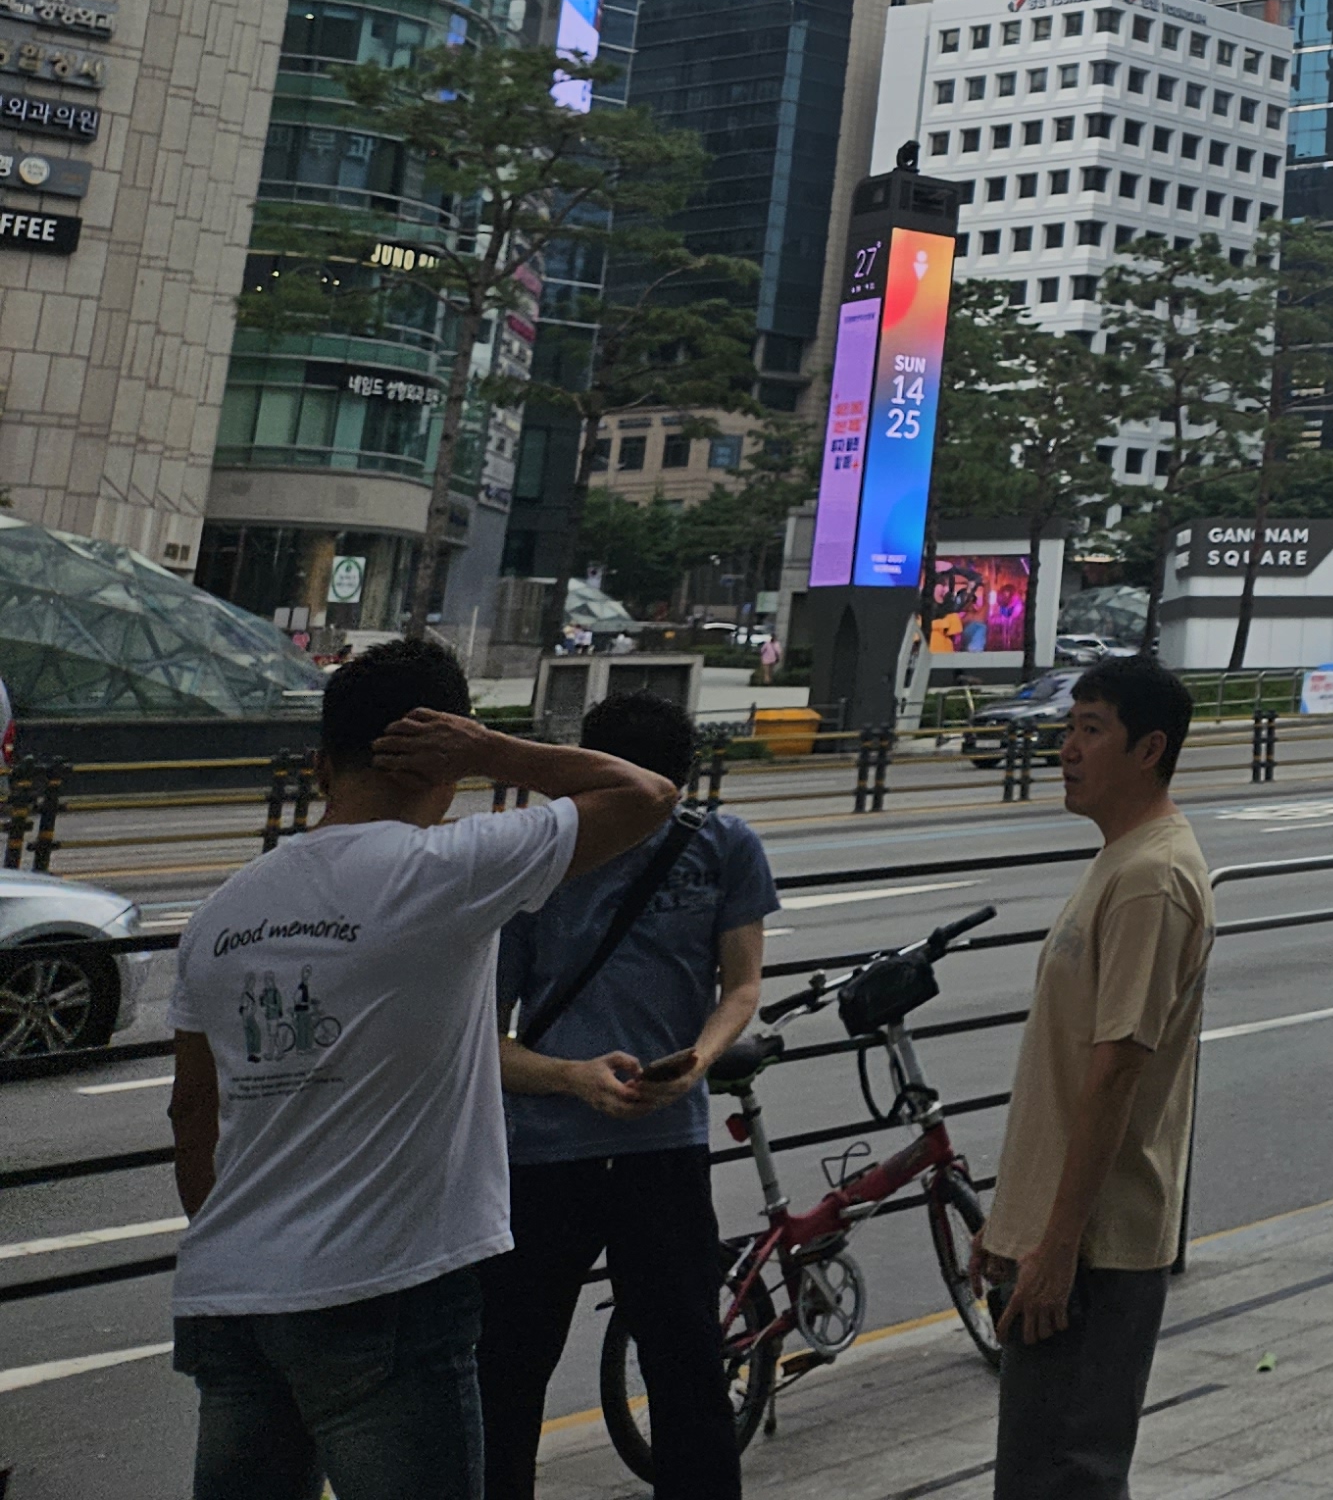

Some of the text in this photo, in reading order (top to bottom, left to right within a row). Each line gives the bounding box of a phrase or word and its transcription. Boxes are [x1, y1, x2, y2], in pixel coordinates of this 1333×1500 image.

[370, 242, 415, 271] JUNO
[894, 355, 926, 373] SUN
[890, 375, 925, 406] 14
[885, 408, 922, 440] 25
[213, 915, 361, 958] Good memories
